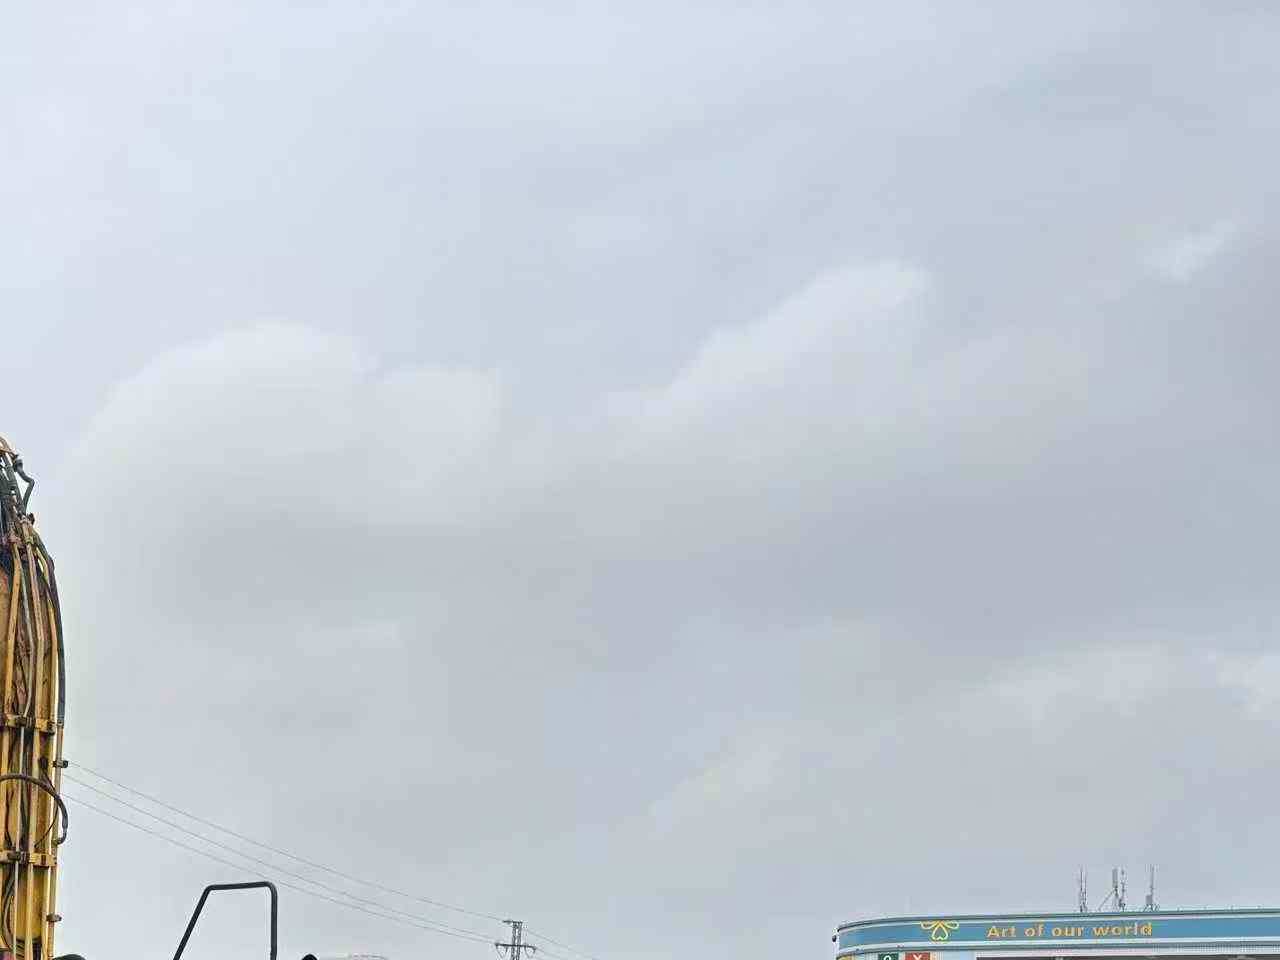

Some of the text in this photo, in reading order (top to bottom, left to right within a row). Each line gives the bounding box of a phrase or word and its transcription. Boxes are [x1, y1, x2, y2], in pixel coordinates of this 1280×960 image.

[987, 922, 1153, 938] Art of our world
